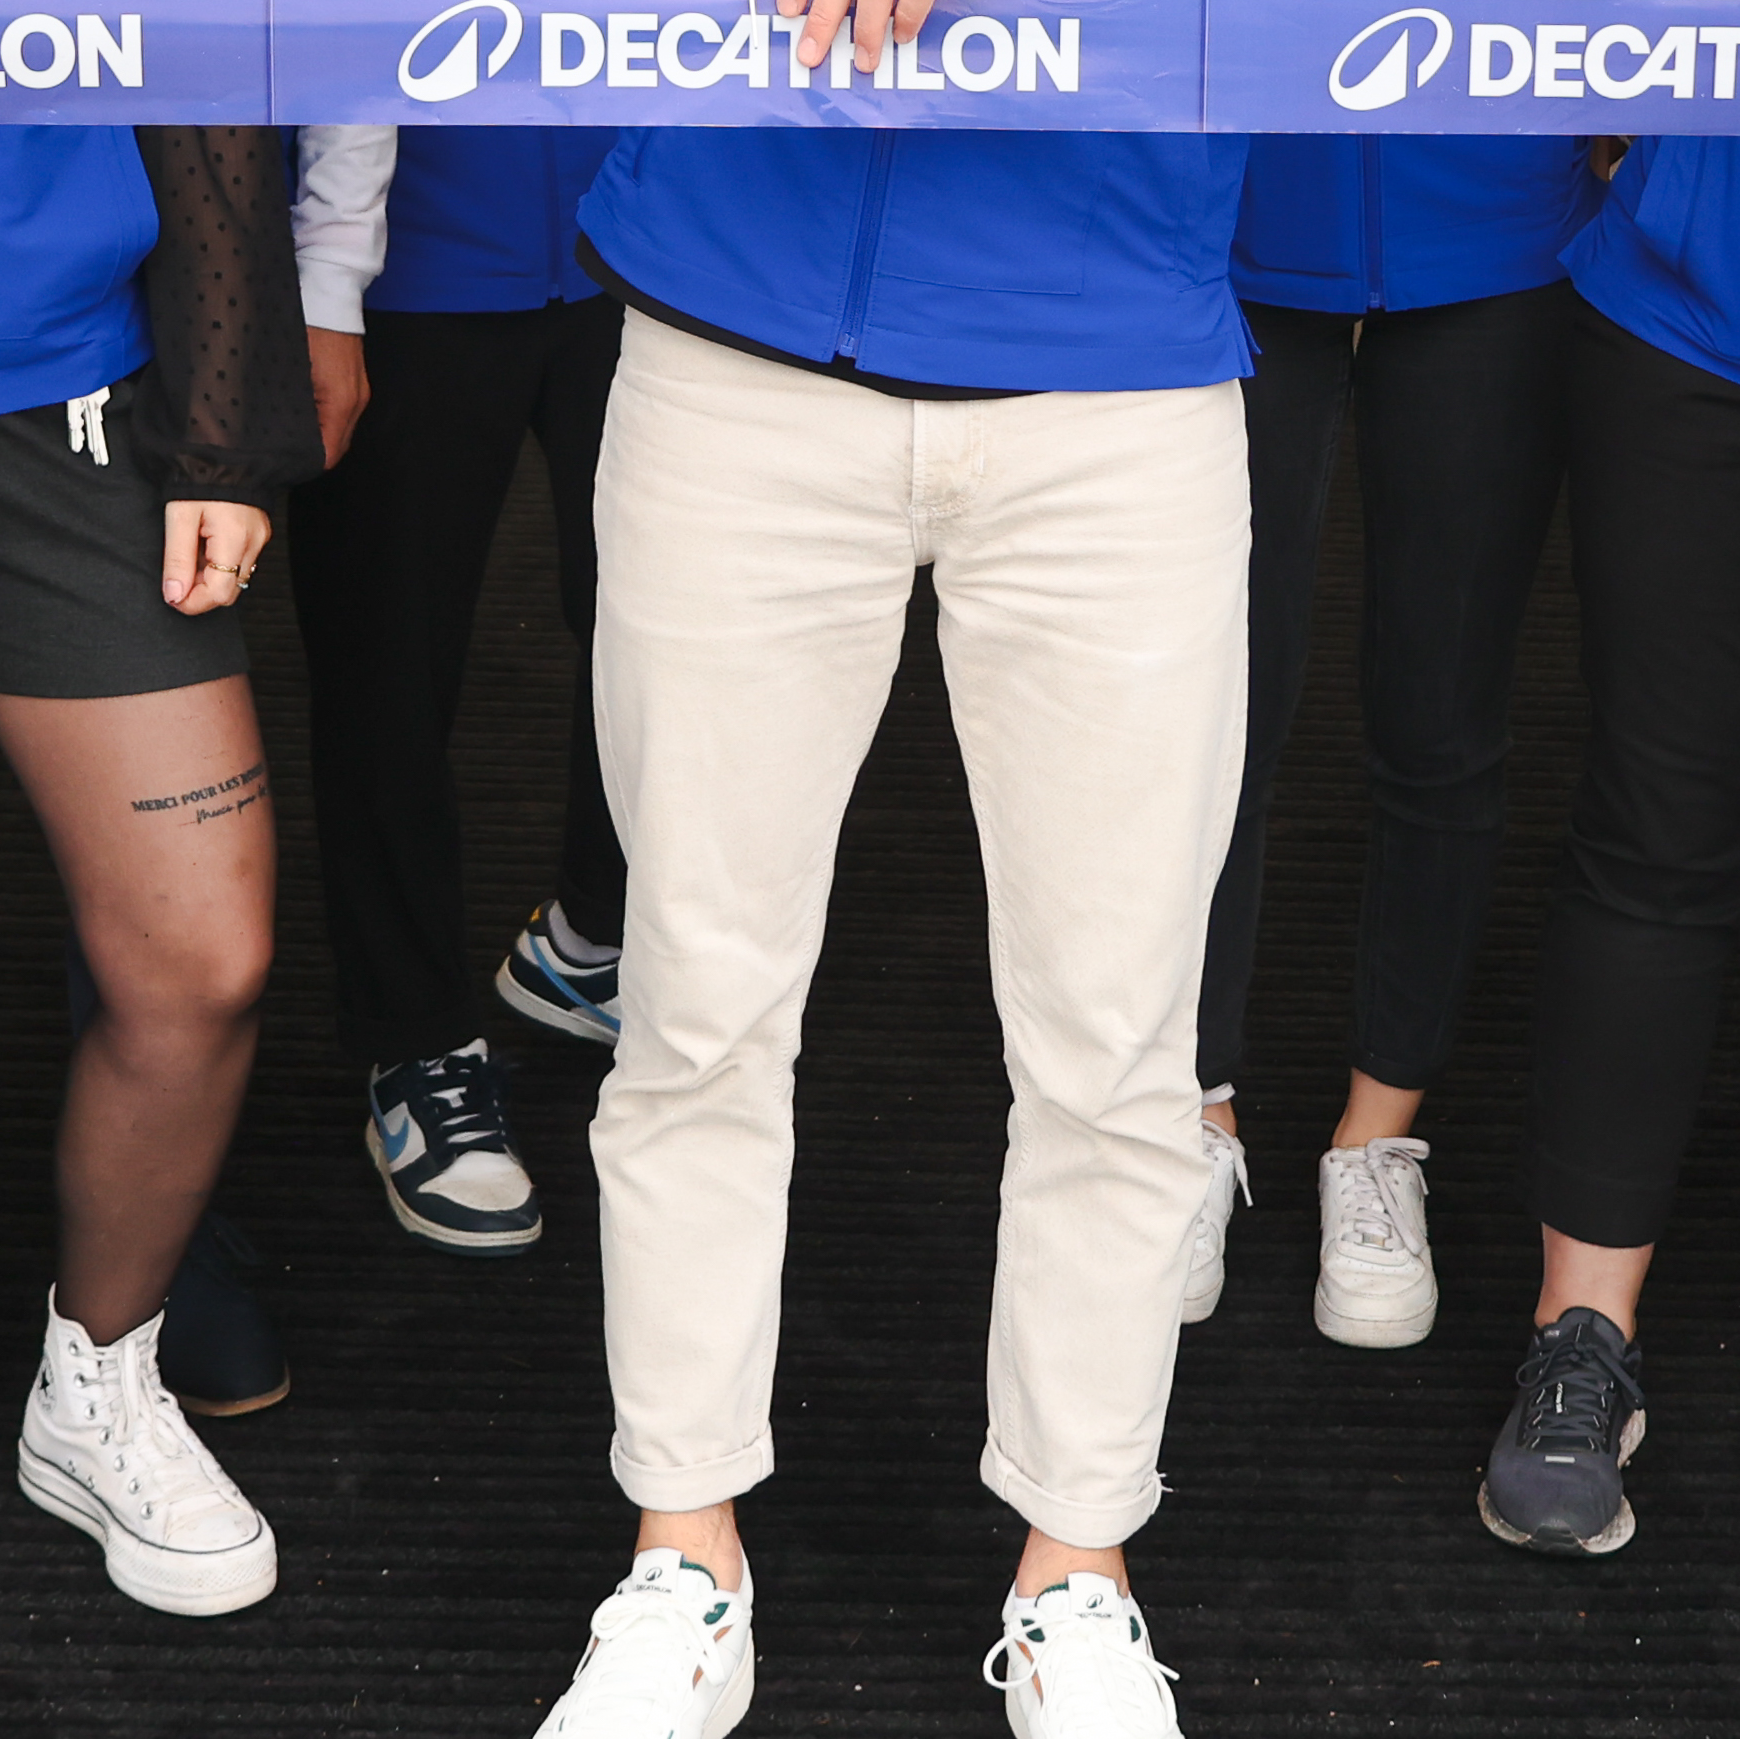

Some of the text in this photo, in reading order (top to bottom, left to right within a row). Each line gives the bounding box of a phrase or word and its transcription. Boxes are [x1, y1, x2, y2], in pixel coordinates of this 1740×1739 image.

[130, 796, 178, 813] MERCI
[181, 785, 217, 805] POUR
[218, 775, 240, 793] LES
